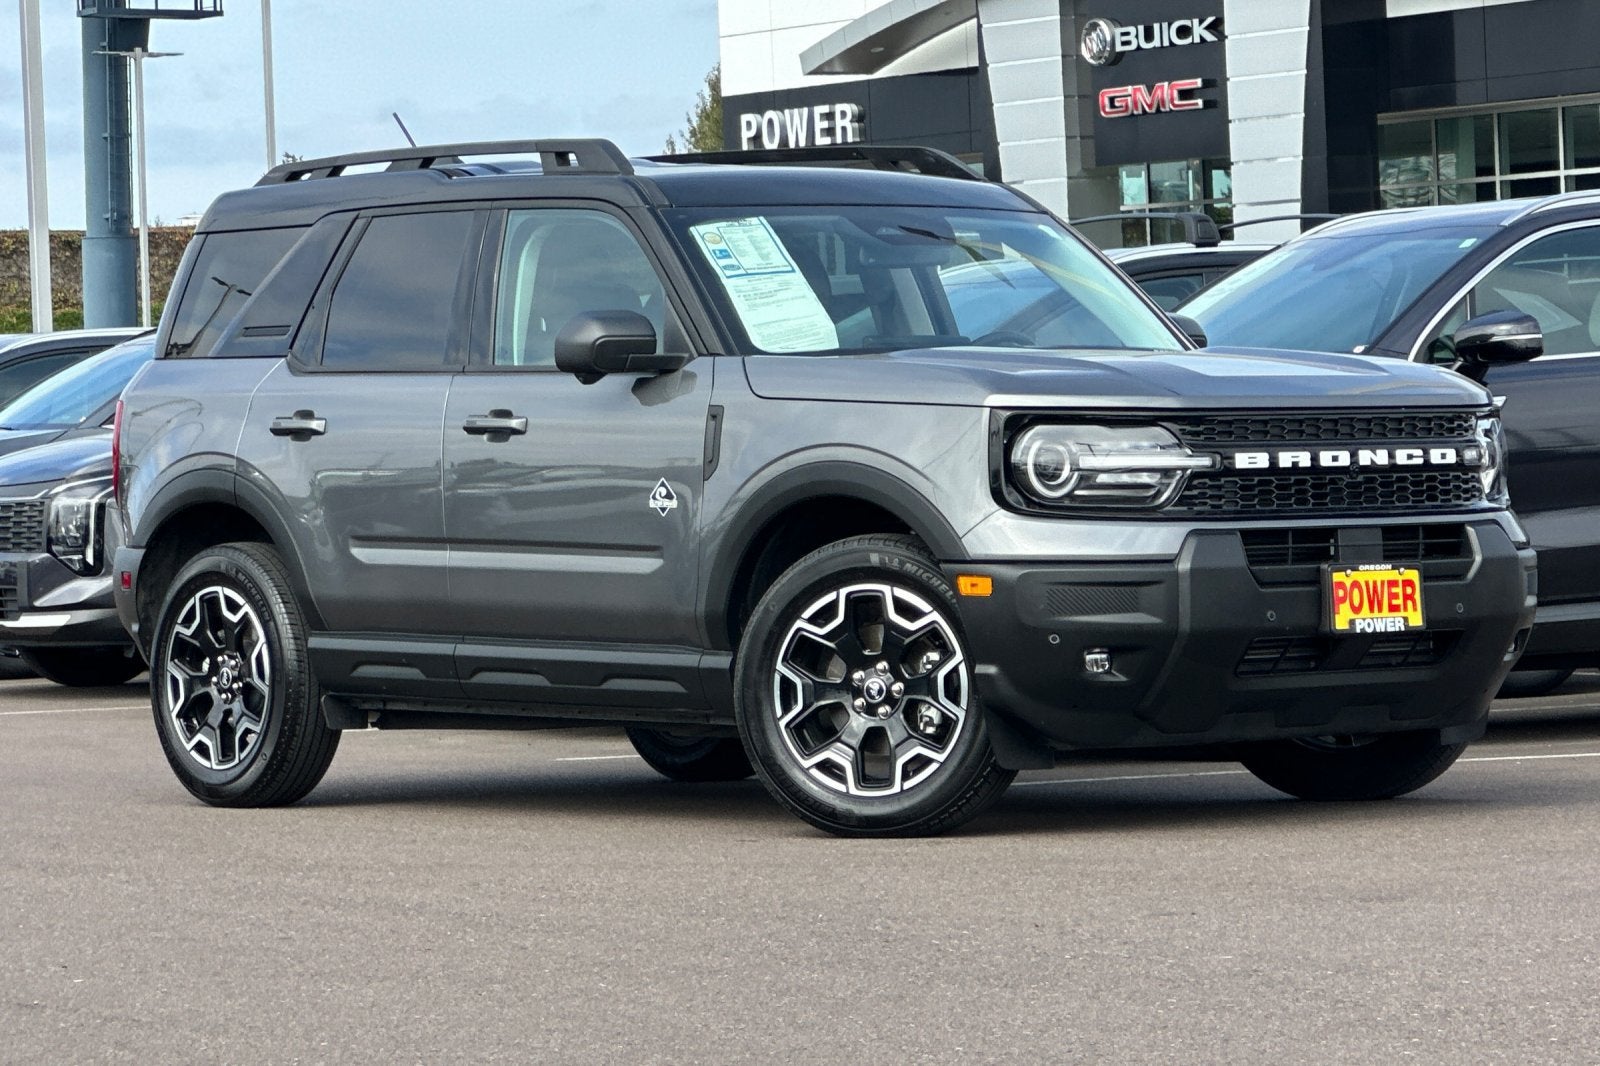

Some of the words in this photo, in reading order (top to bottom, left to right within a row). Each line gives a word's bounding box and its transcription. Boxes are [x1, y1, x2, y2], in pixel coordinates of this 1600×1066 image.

[1114, 16, 1219, 53] BUICK
[1099, 78, 1203, 118] GMC
[740, 102, 858, 151] POWER
[1234, 448, 1457, 469] BRONCO
[1358, 563, 1393, 571] OREGON
[1333, 579, 1418, 615] POWER
[1355, 616, 1406, 633] POWER
